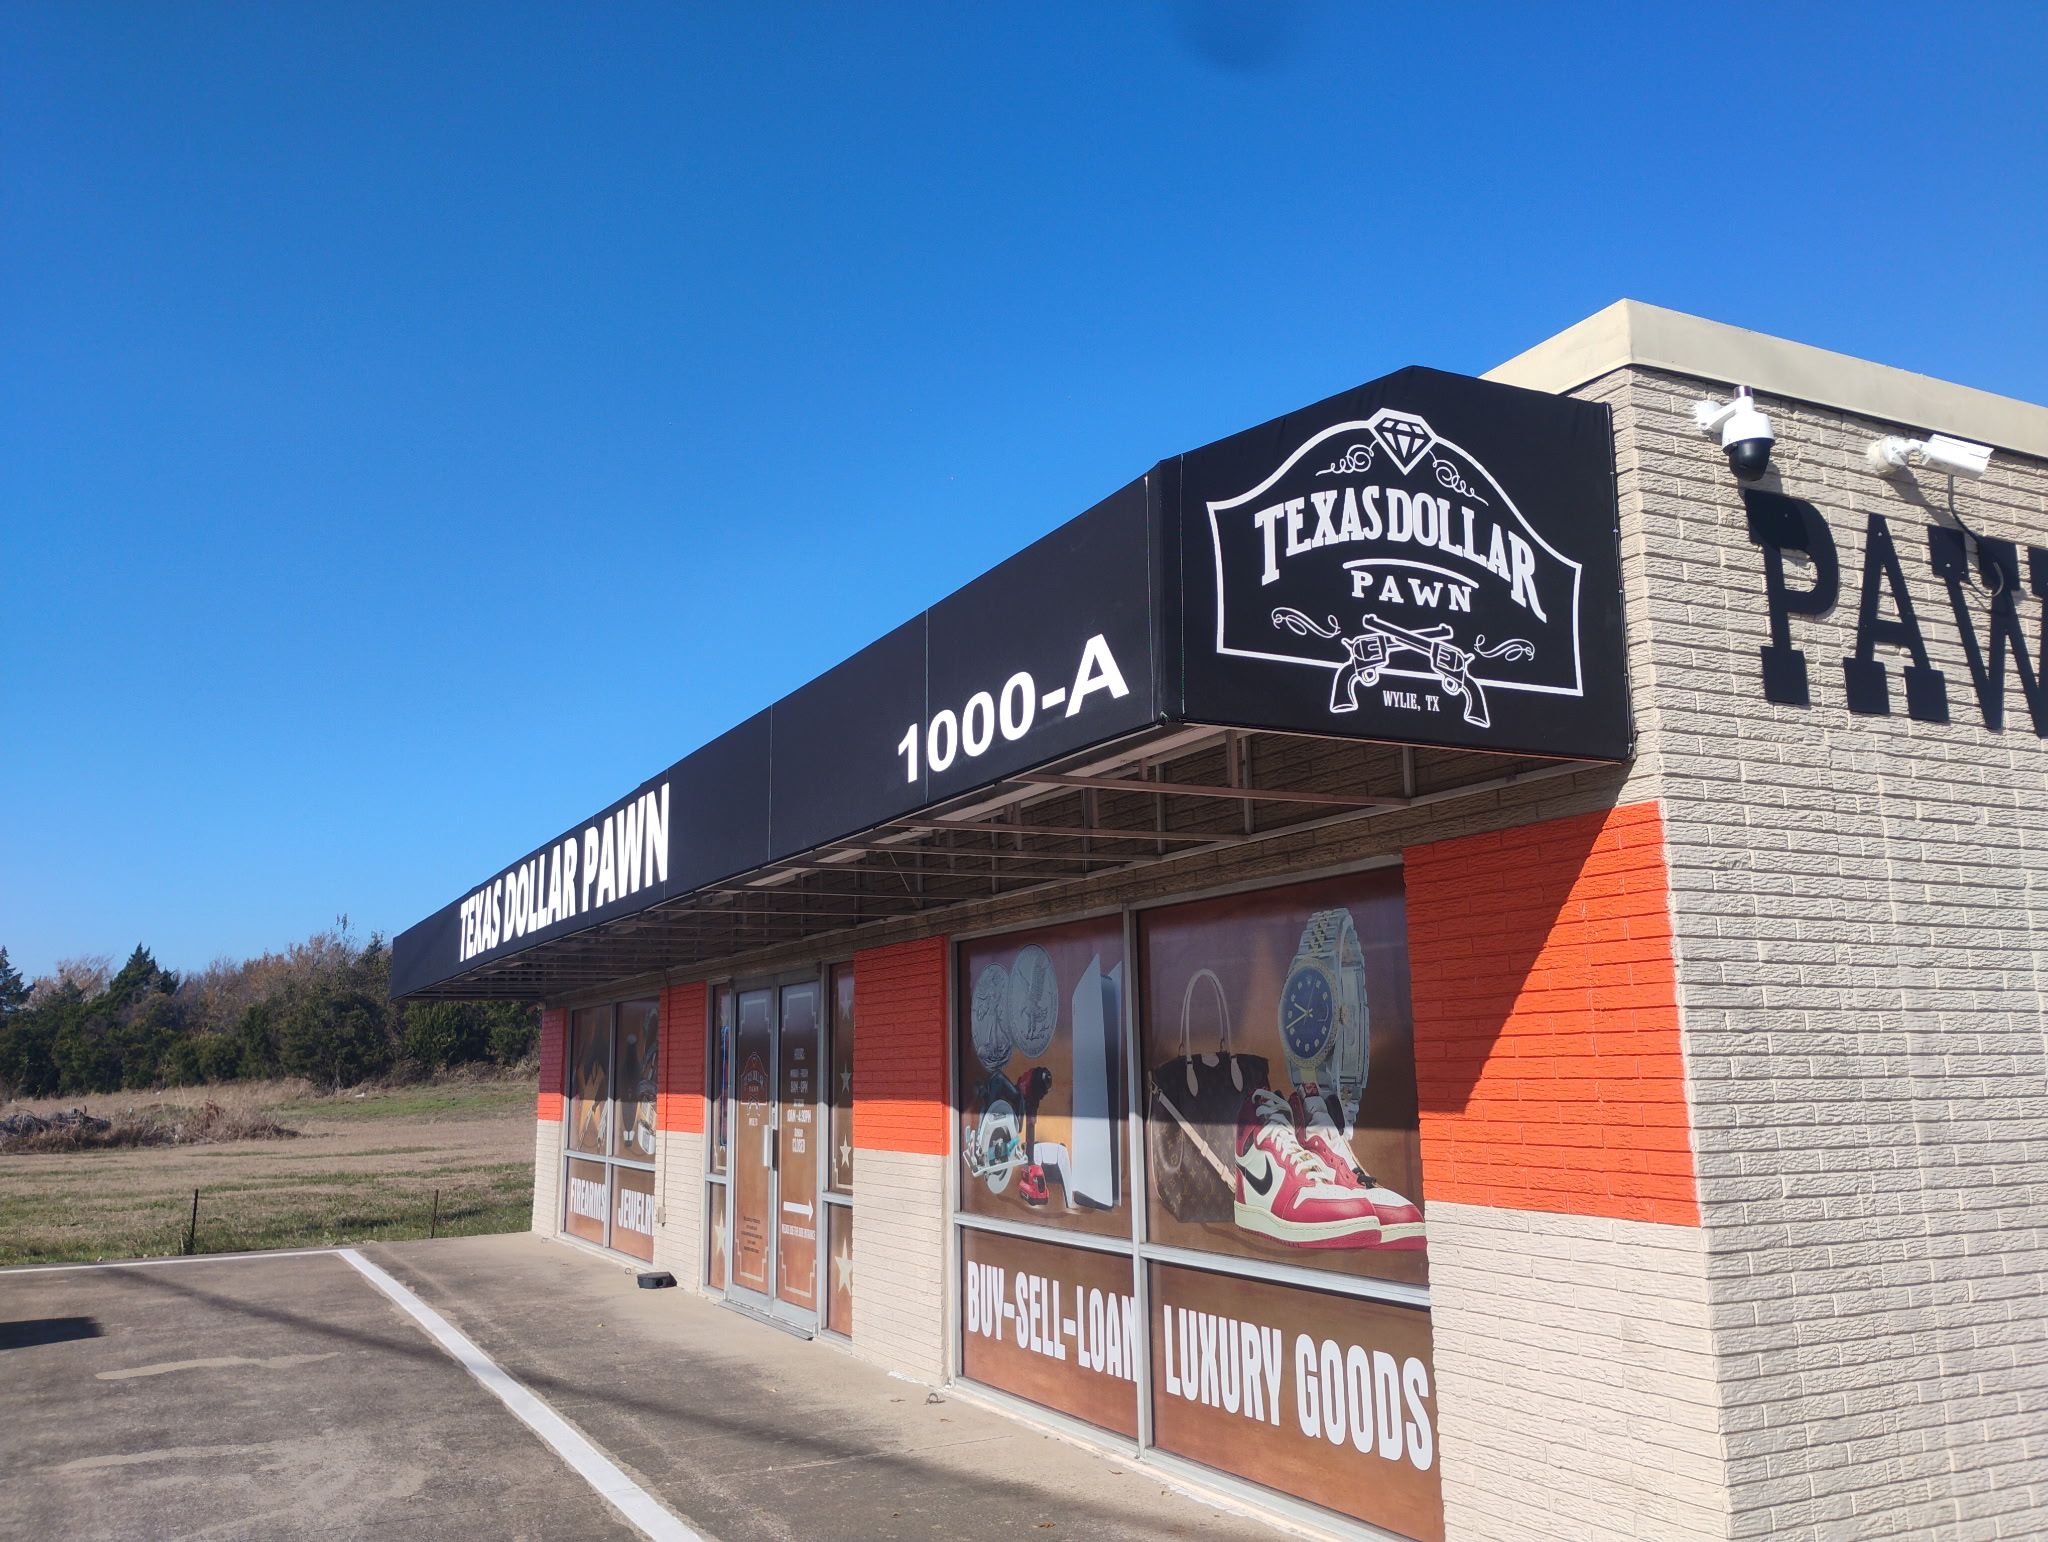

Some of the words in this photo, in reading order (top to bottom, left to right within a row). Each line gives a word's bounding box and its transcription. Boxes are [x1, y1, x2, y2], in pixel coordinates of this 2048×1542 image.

[1254, 485, 1383, 587] TEXAS
[1386, 488, 1547, 624] DOLLAR
[1351, 569, 1472, 613] PAWN
[898, 633, 1130, 784] 1000-A
[1382, 689, 1421, 711] WYLIE,
[1425, 694, 1440, 712] TX
[459, 878, 502, 963] TEXAS
[503, 837, 578, 944] DOLLAR
[581, 782, 670, 913] PAWN
[570, 1177, 606, 1222] FIREARMS
[967, 1261, 1137, 1383] BUY-SELL-LOAN
[1163, 1304, 1282, 1427] LUXURY
[1295, 1332, 1433, 1472] GOODS
